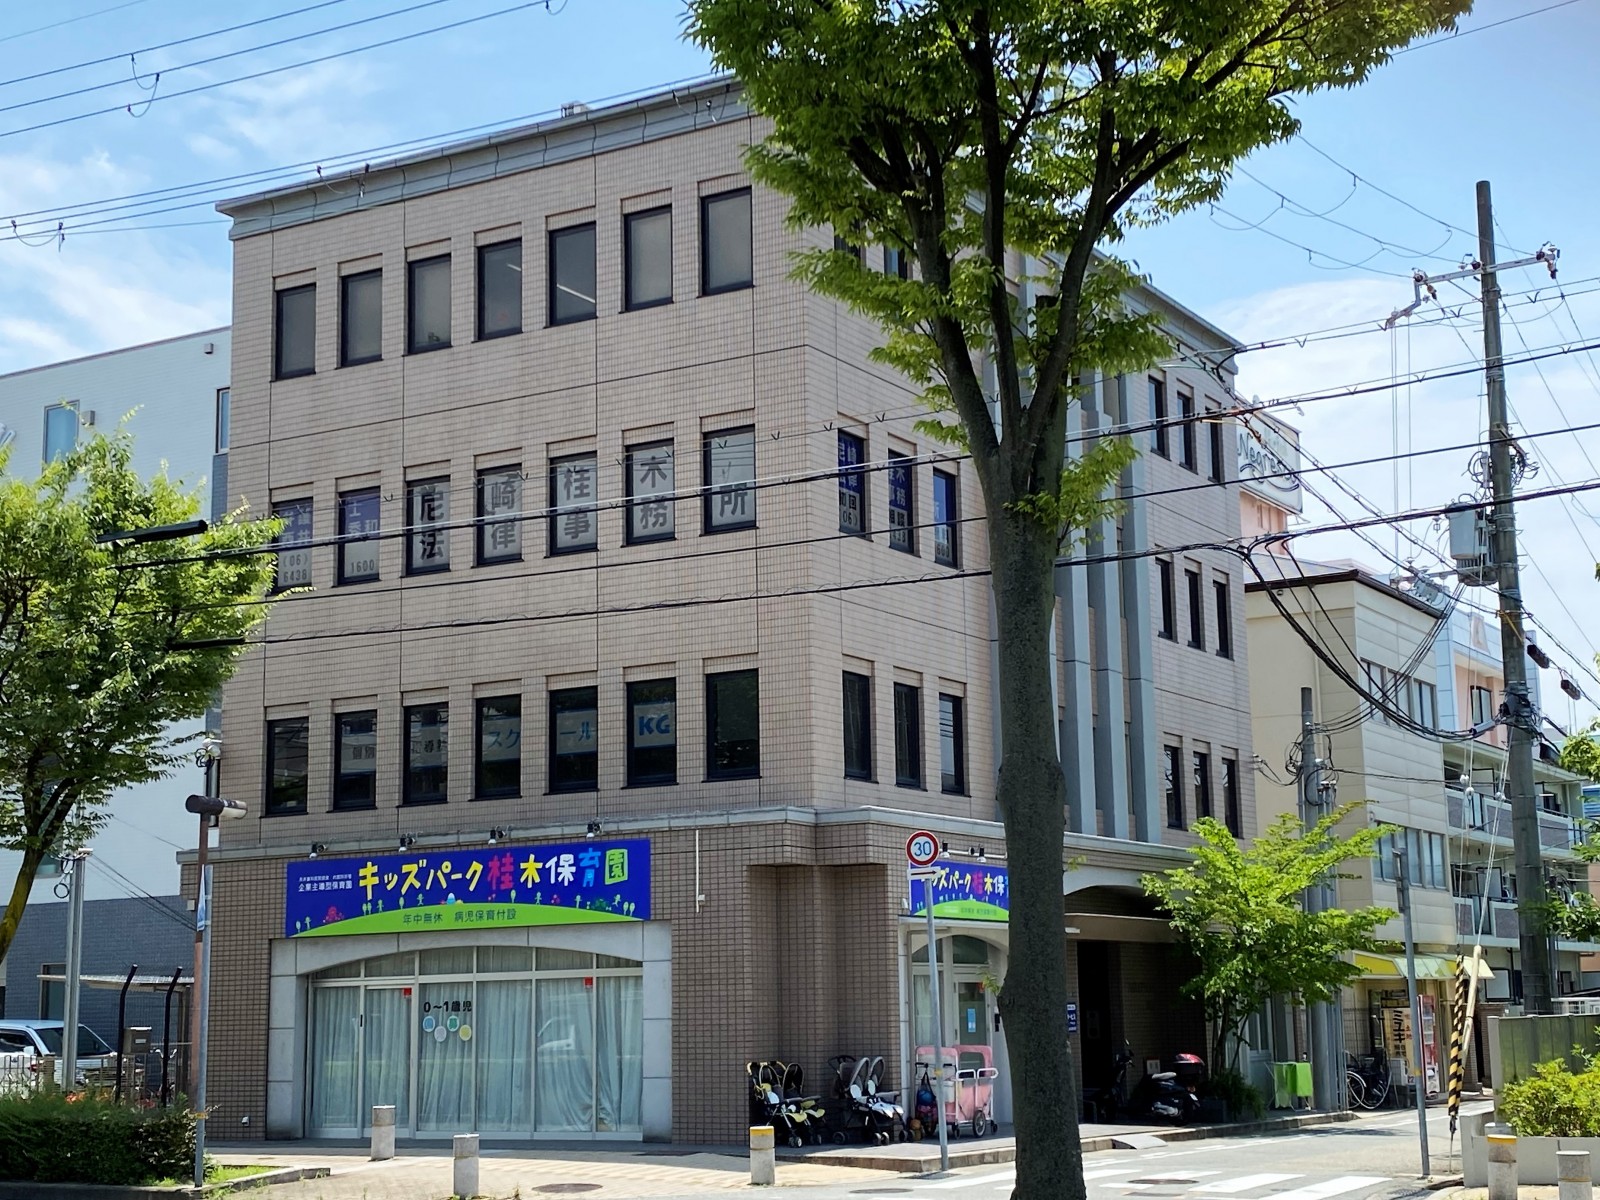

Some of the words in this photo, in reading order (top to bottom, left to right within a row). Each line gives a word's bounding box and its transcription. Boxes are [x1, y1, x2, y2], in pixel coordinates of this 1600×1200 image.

[282, 554, 308, 567] (06)
[283, 569, 308, 583] 6438
[350, 559, 375, 574] 1600
[638, 714, 671, 736] KG
[913, 841, 932, 857] 30
[403, 912, 443, 925] 年中無休
